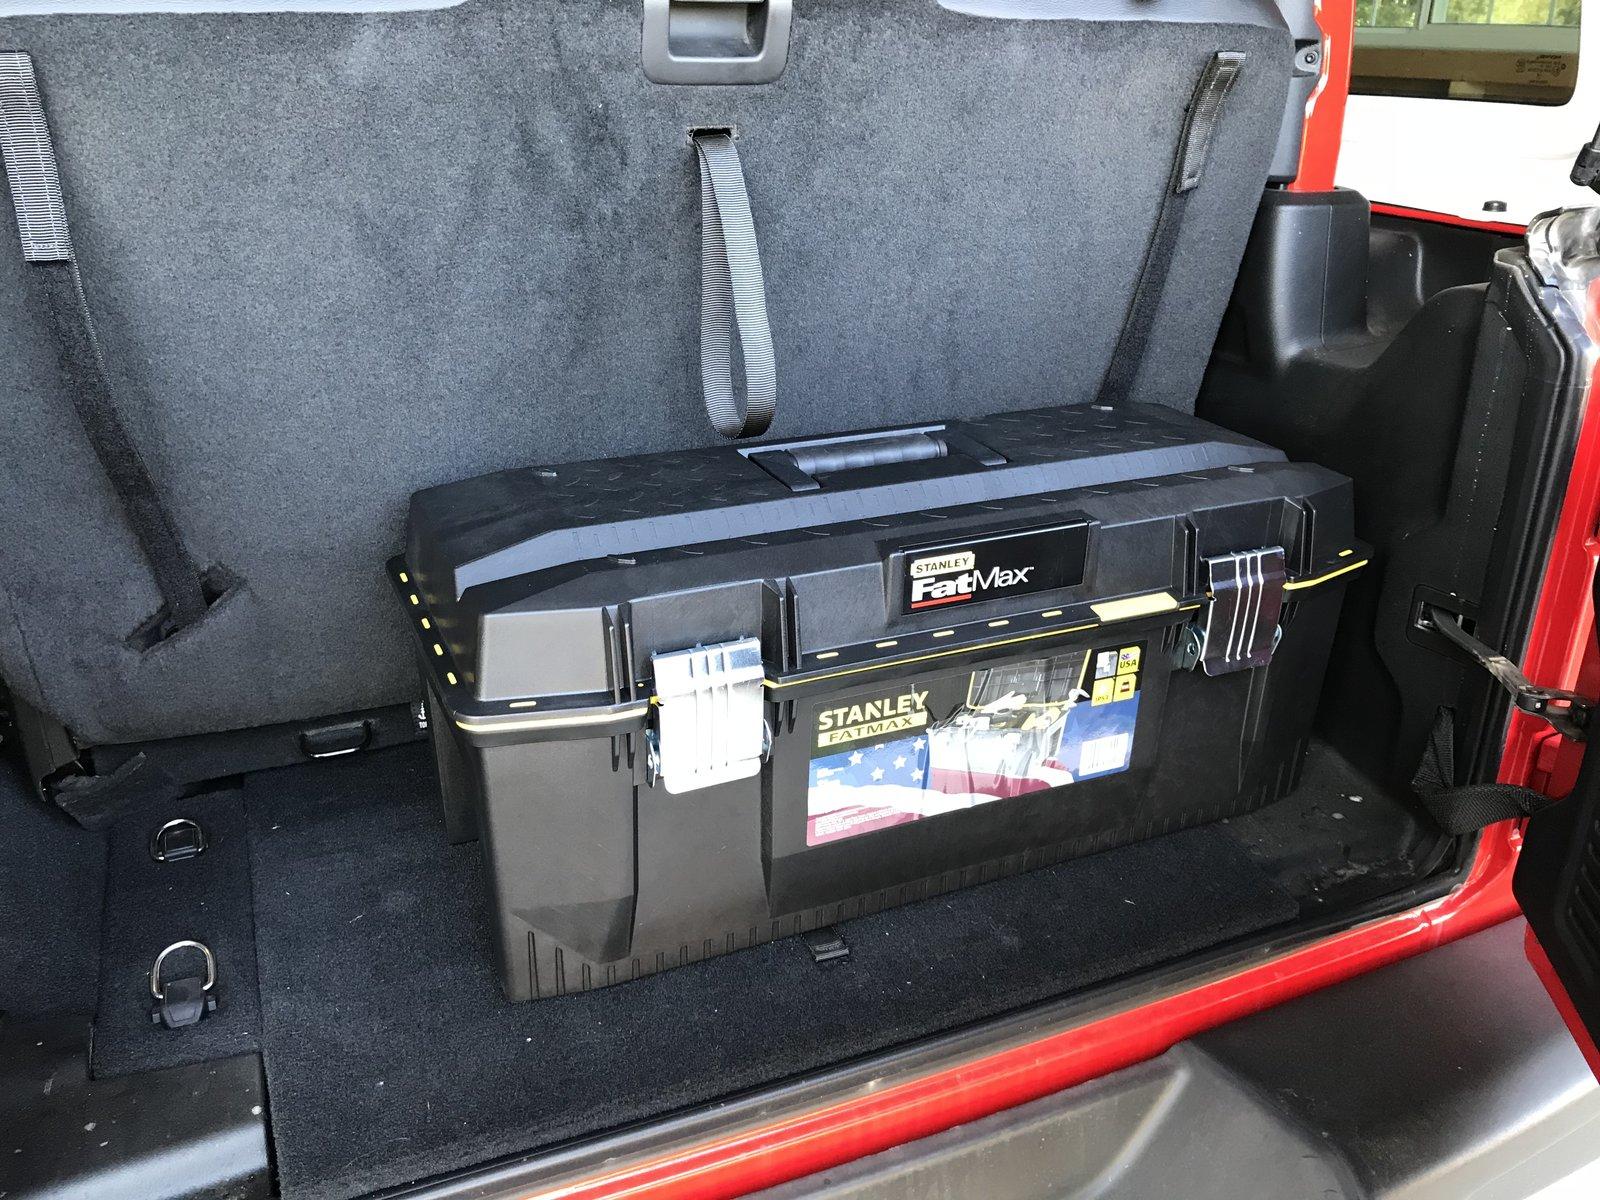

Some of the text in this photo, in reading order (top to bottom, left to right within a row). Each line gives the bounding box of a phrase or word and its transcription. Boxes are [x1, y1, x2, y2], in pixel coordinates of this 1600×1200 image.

[915, 557, 970, 574] STANLEY
[1119, 659, 1137, 669] USA
[818, 690, 929, 731] STANLEY
[829, 717, 913, 743] FATMAX
